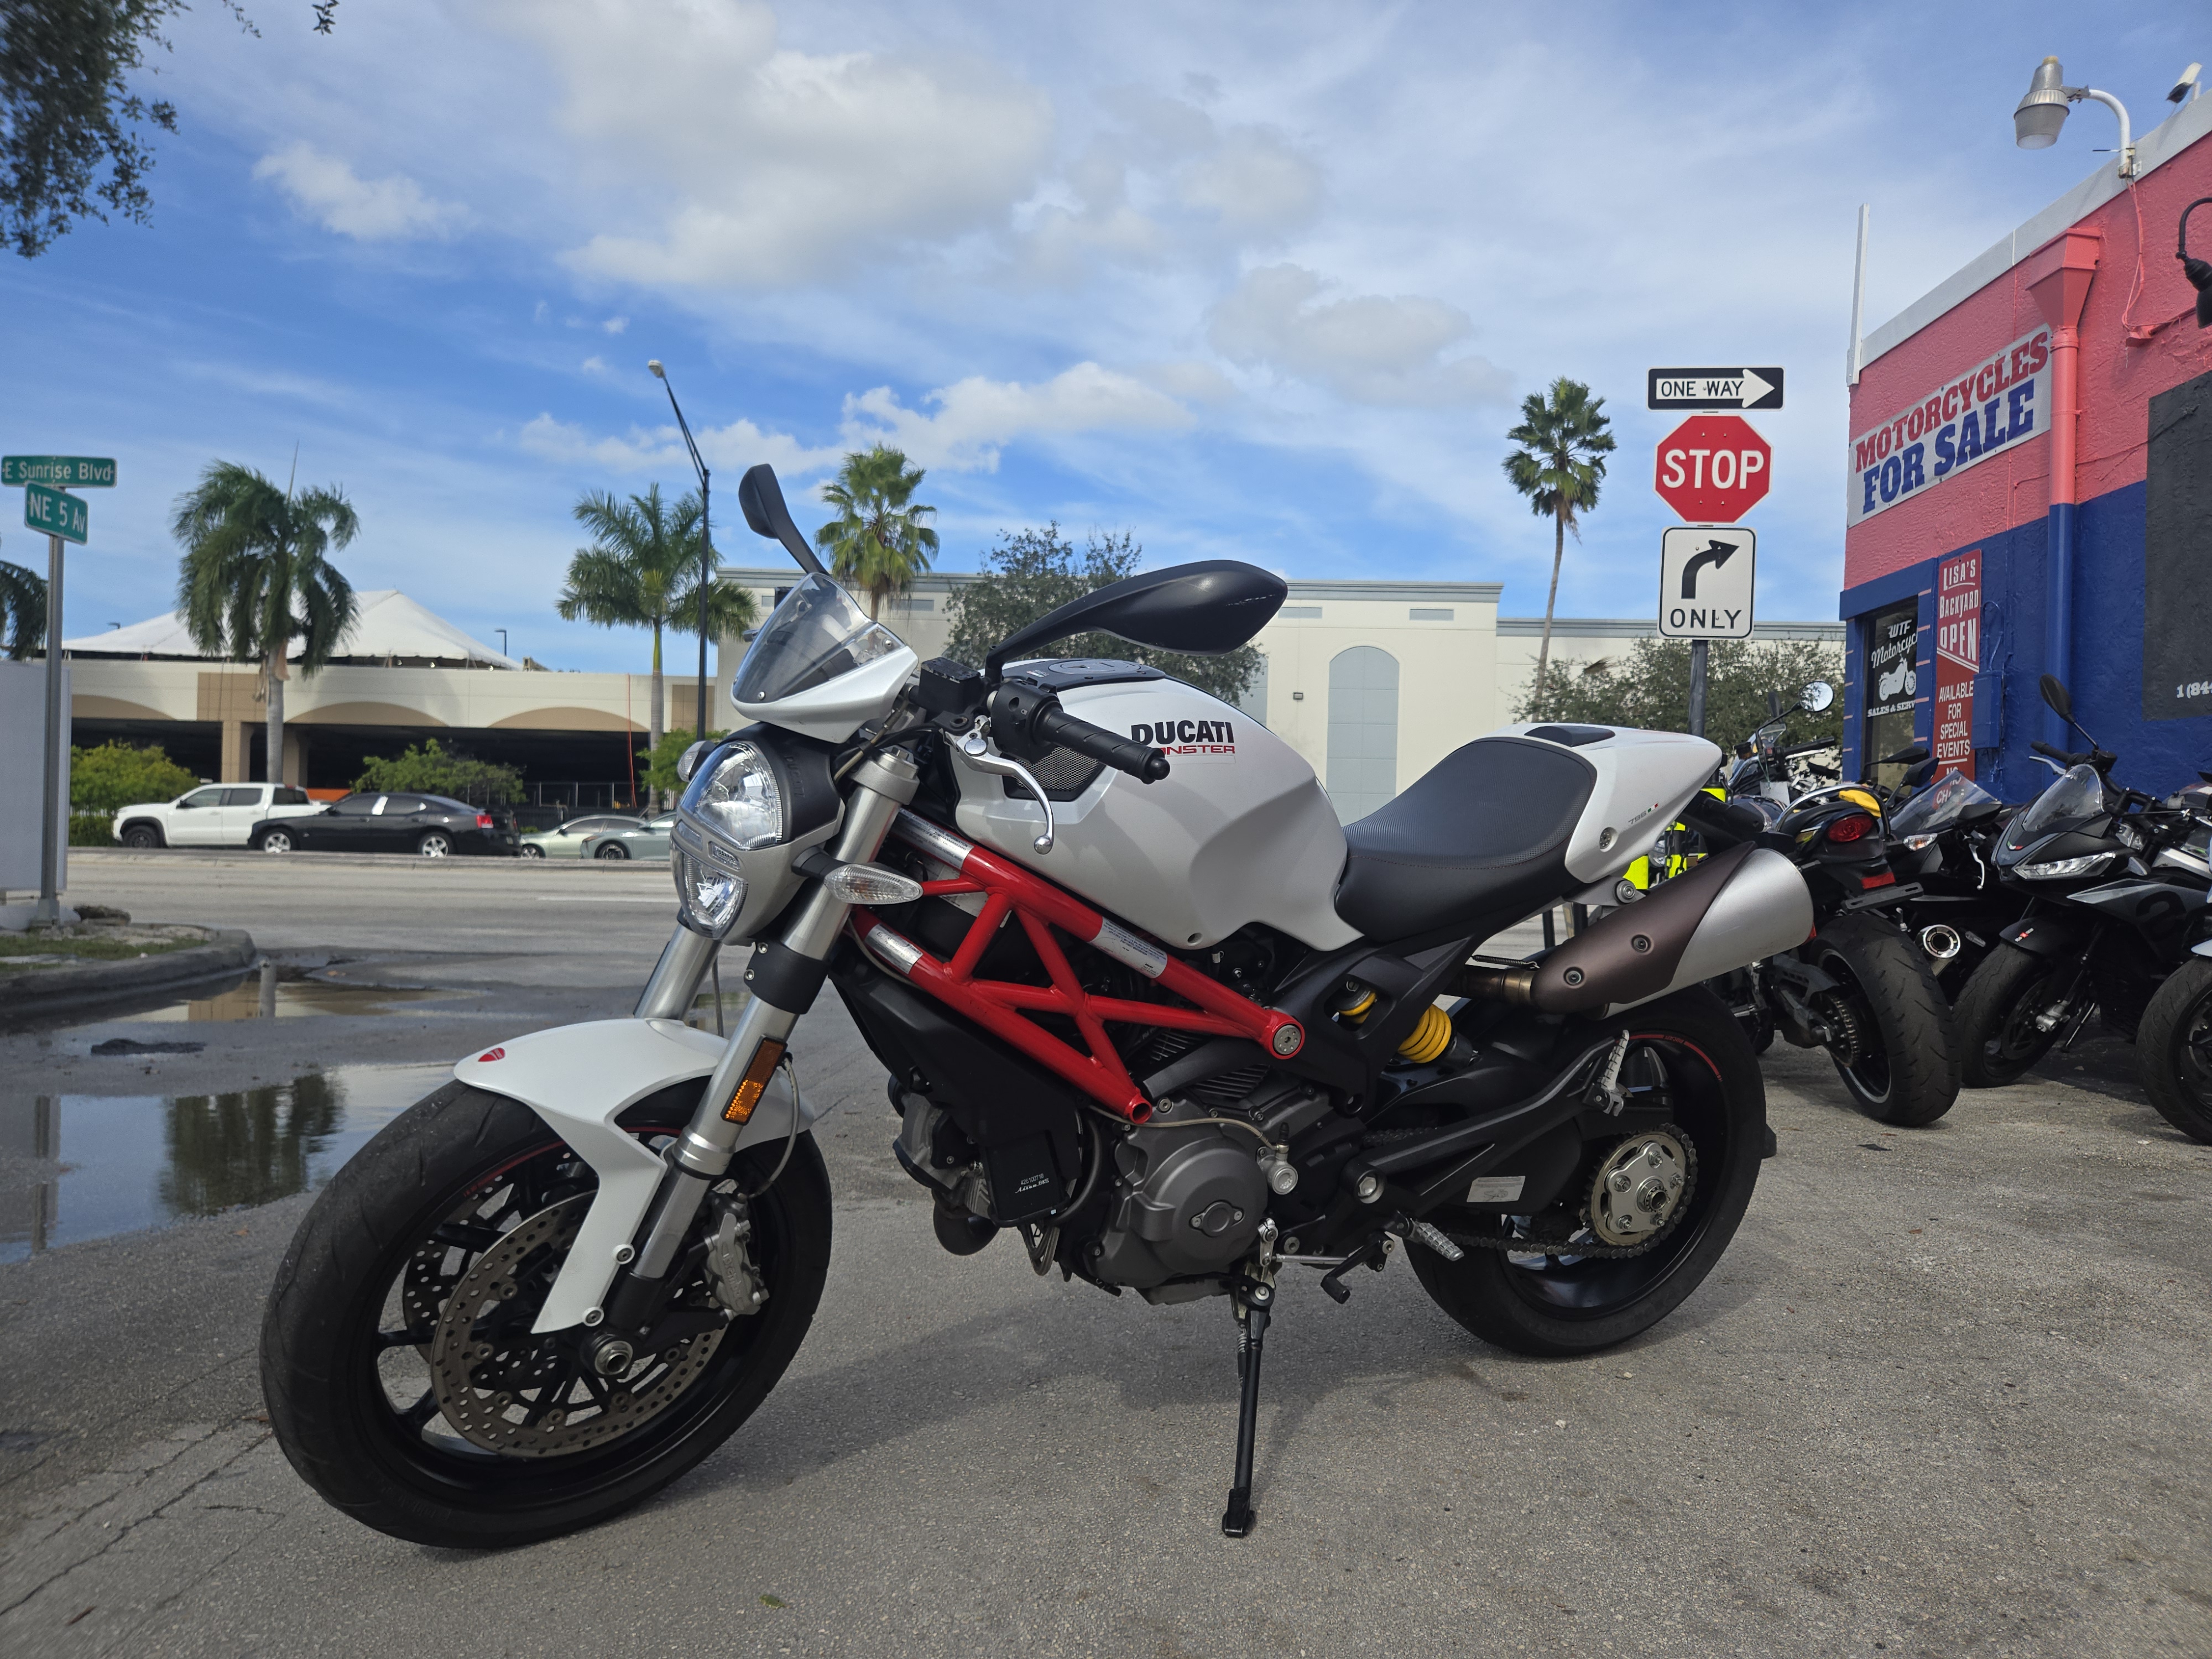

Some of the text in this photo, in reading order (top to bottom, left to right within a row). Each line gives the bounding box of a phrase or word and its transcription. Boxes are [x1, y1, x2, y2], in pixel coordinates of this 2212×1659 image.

[1661, 380, 1744, 397] ONE WAY
[1856, 332, 2048, 473] MOTORCYCLES
[1863, 378, 2034, 514] FOR SALE
[4, 461, 111, 482] E Sunrise Blvd
[1662, 448, 1764, 489] STOP
[30, 491, 53, 523] NE
[59, 500, 67, 527] 5
[1943, 559, 1976, 591] LISA'S
[1670, 608, 1741, 629] ONLY
[1887, 619, 1912, 639] WTF
[1939, 618, 1976, 662] OPEN
[1939, 680, 1974, 703] AVAILABLE
[2177, 684, 2184, 698] 1
[1867, 705, 1890, 717] SALES
[1890, 703, 1896, 712] &
[1948, 702, 1961, 720] FOR
[1131, 720, 1234, 745] DUCATI
[1940, 721, 1968, 740] SPECIAL
[1160, 745, 1235, 755] NSTER
[1937, 739, 1970, 759] EVENTS
[1628, 810, 1646, 825] 796
